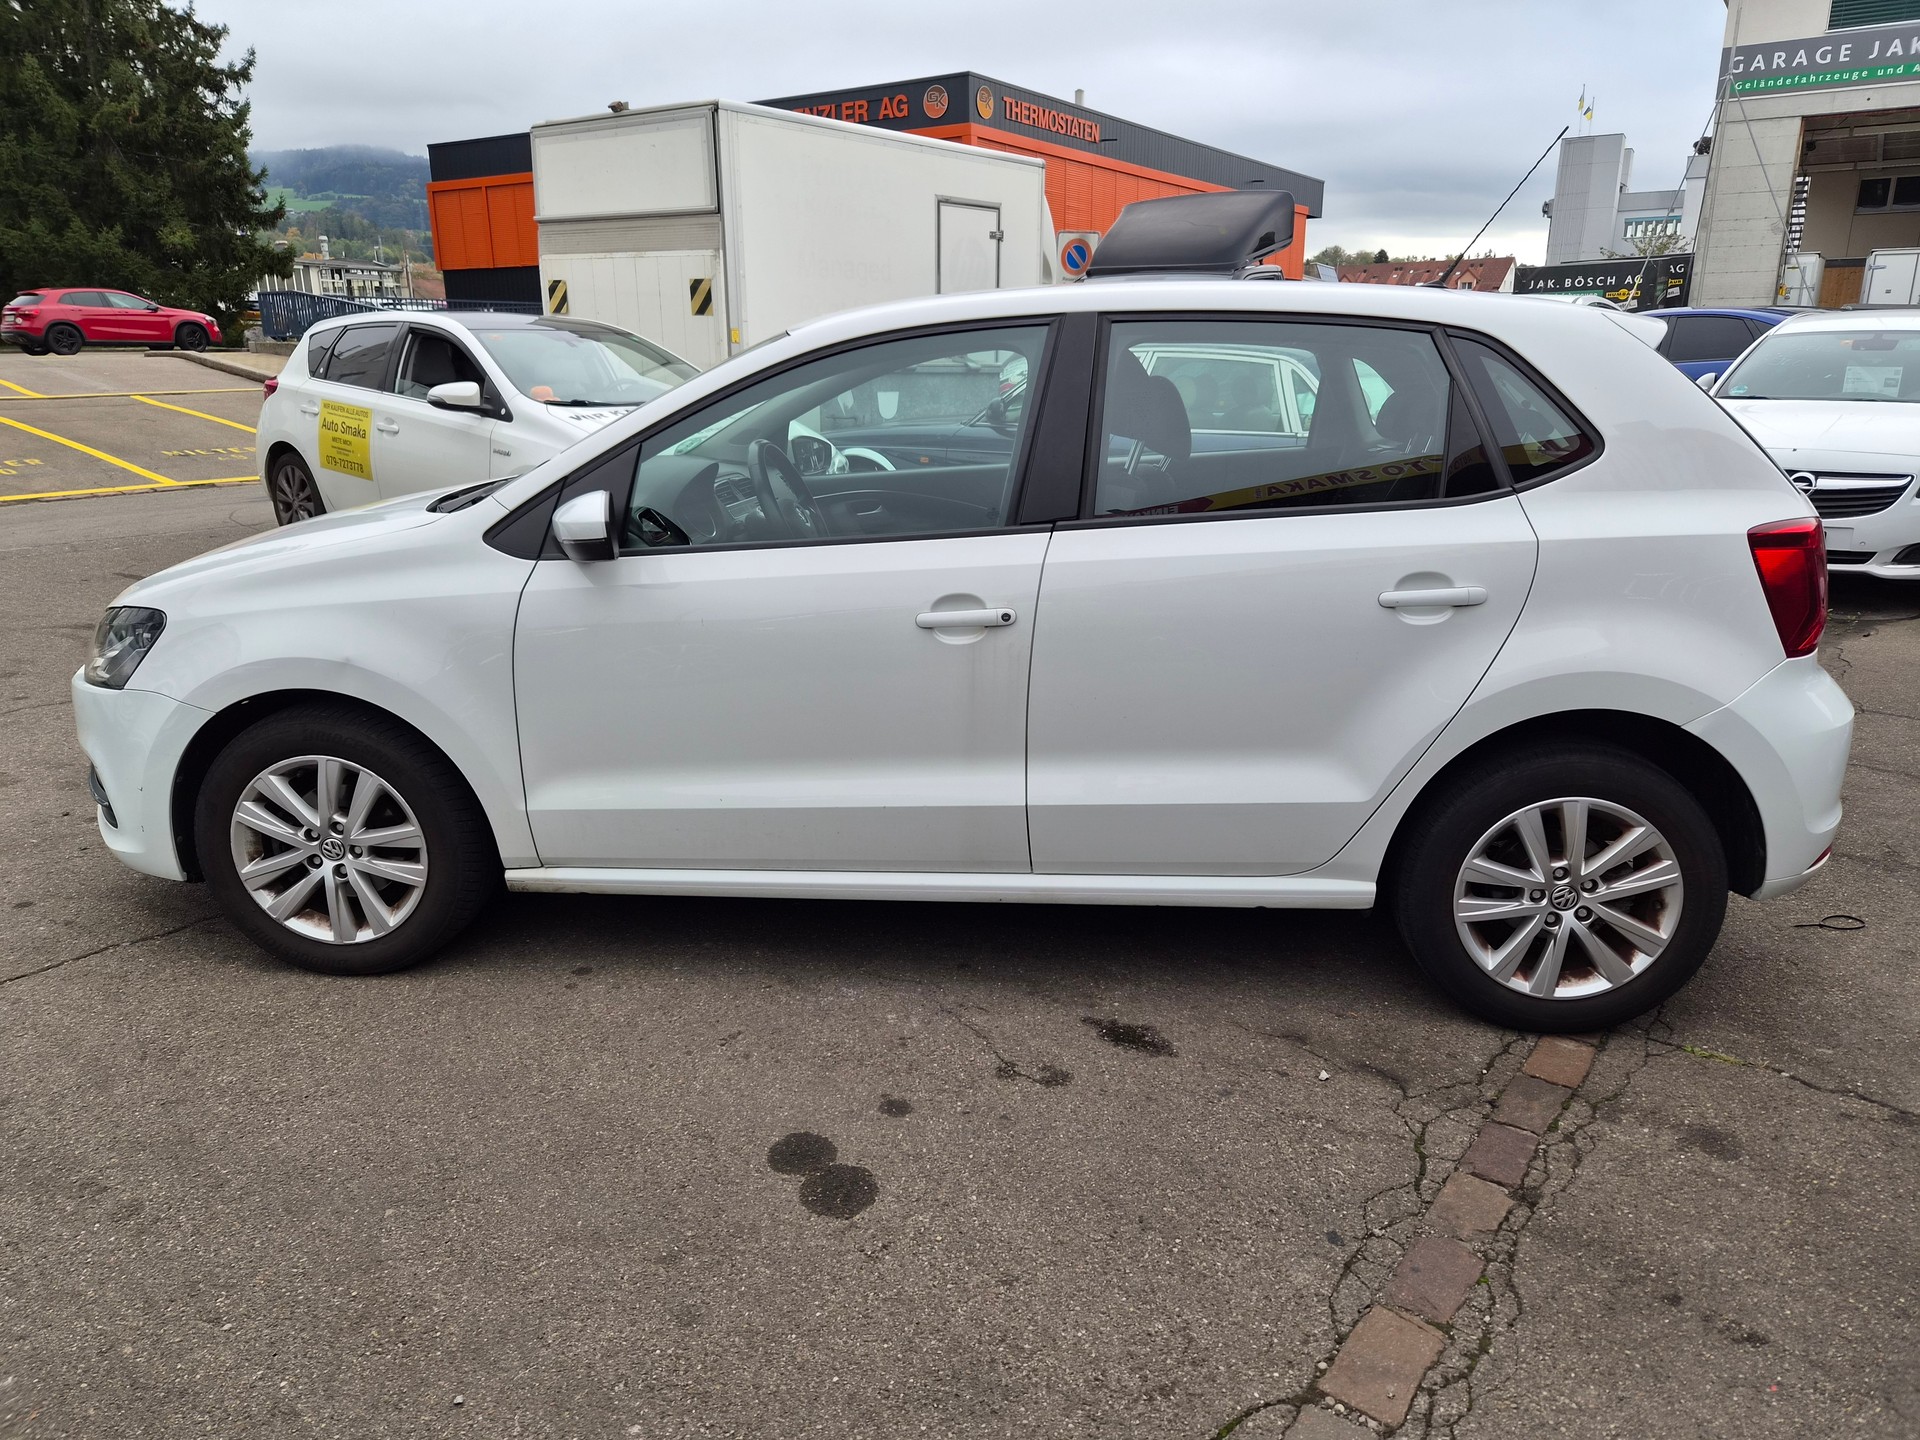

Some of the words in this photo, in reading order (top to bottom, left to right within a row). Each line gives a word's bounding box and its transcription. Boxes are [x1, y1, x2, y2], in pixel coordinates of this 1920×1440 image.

[1732, 43, 1852, 74] GARAGE
[1735, 69, 1868, 90] Geländefahrzeuge
[1877, 64, 1904, 76] und
[878, 94, 909, 120] AG
[1003, 96, 1100, 144] THERMOSTATEN
[1529, 279, 1560, 290] JAK.
[1565, 275, 1616, 288] BÖSCH
[1624, 274, 1643, 285] AG
[321, 417, 339, 433] Auto
[340, 421, 366, 439] Smaka
[325, 454, 364, 473] 079-7273778
